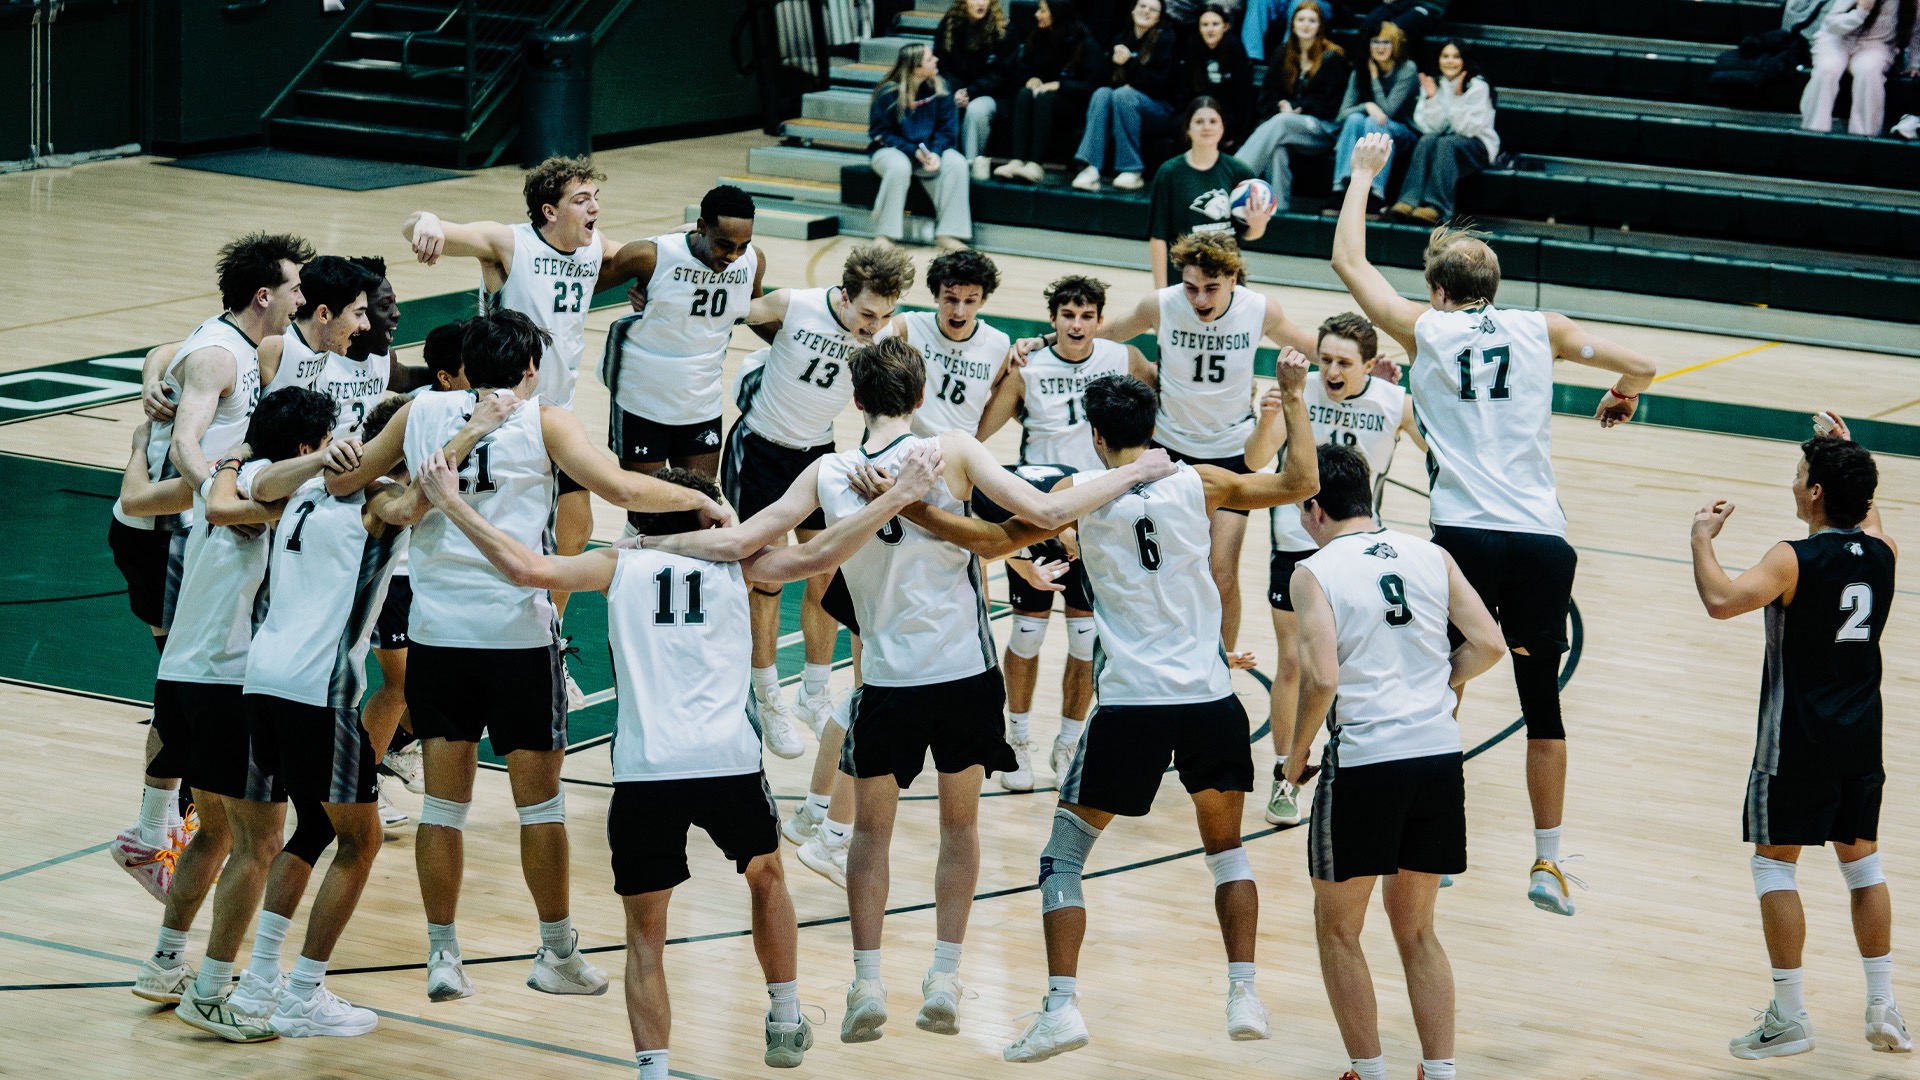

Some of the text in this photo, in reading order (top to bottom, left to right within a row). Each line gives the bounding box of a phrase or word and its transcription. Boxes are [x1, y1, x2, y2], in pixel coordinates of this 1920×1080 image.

[534, 257, 598, 277] STEVENSON
[673, 266, 748, 285] STEVENSON
[554, 281, 584, 313] 23
[689, 288, 728, 317] 20
[793, 329, 855, 361] STEVENS
[1171, 330, 1250, 350] STEVENSON
[799, 357, 840, 389] 13
[1192, 355, 1226, 383] 15
[1455, 342, 1512, 402] 17
[328, 377, 383, 399] STEVENSON
[1309, 405, 1385, 432] STEVENSON
[283, 498, 316, 555] 7
[1132, 513, 1163, 574] 6
[653, 565, 707, 626] 11
[1376, 571, 1415, 629] 9
[1834, 582, 1873, 643] 2
